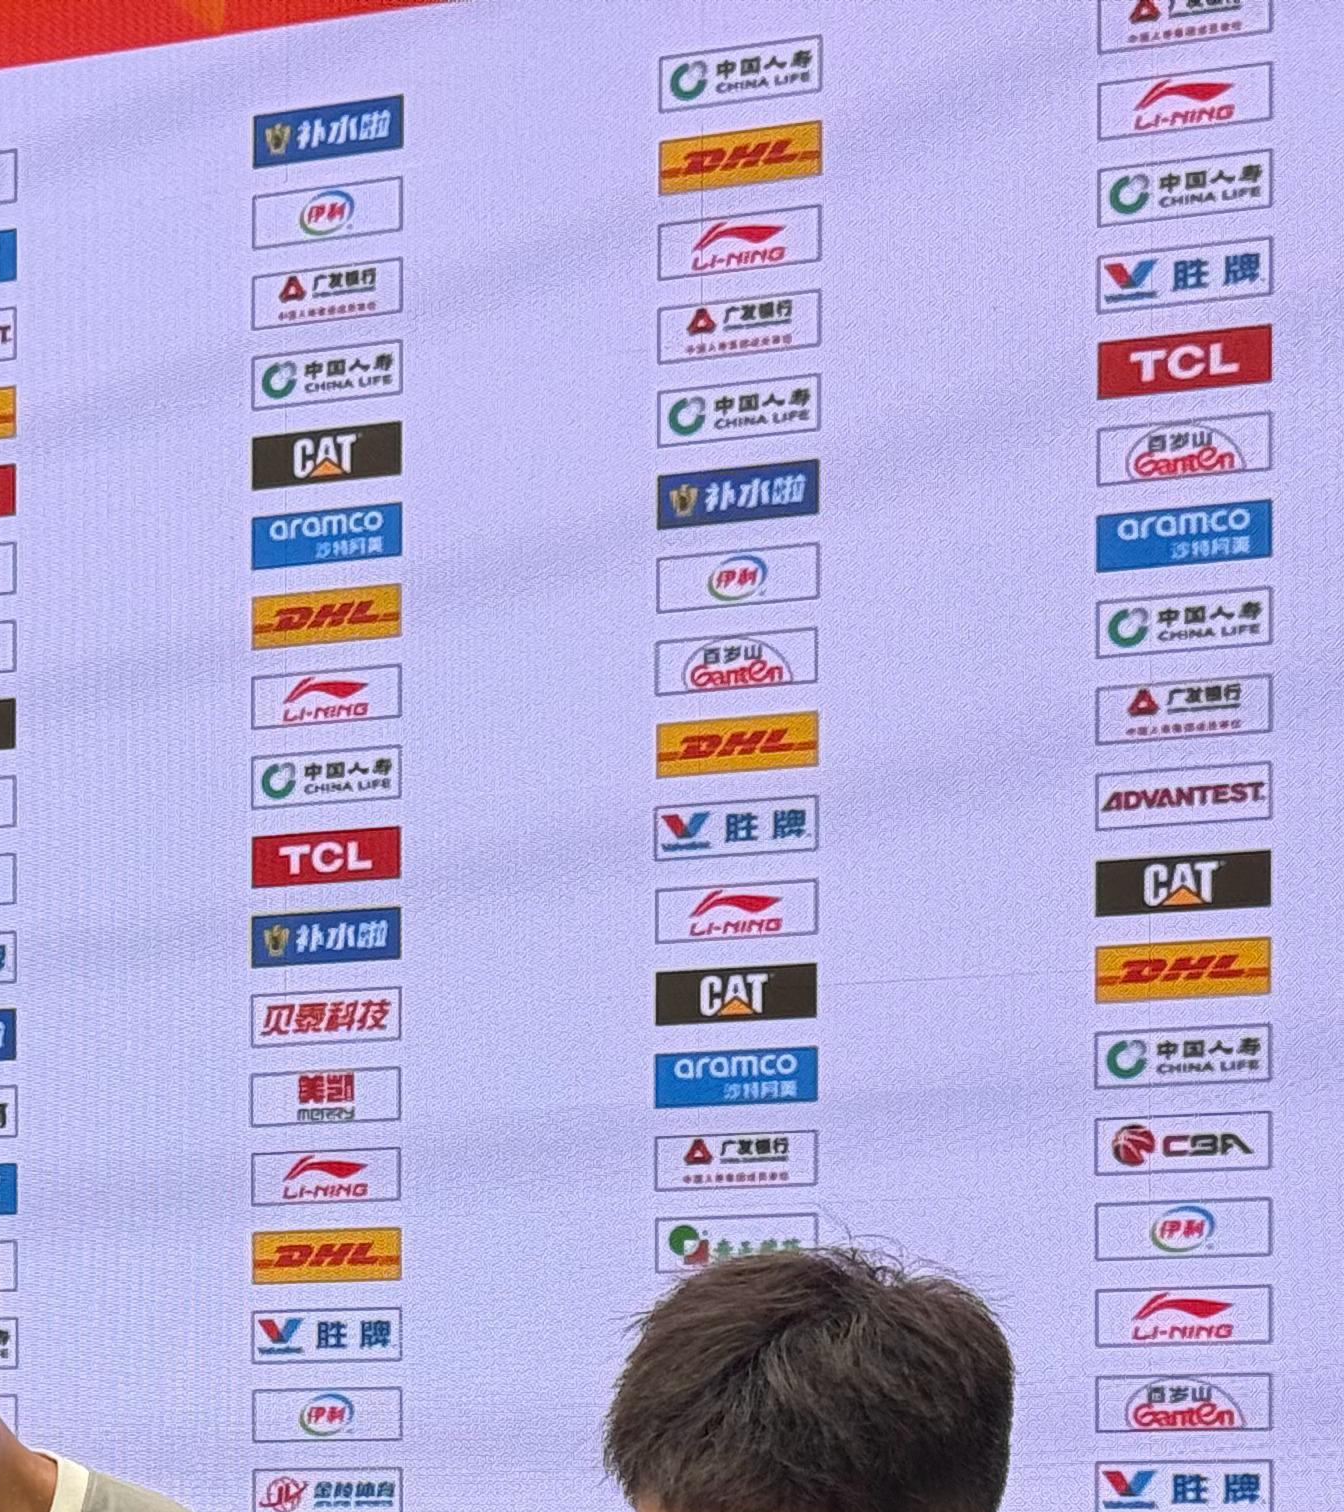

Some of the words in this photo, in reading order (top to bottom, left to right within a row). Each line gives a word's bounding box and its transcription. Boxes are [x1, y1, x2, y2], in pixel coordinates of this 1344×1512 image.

[717, 49, 811, 79] 中国人寿
[716, 76, 770, 94] CHINA
[775, 70, 811, 86] LIFE
[297, 108, 389, 150] 补水啦
[1136, 105, 1236, 131] LI-NING
[681, 138, 797, 177] DHL
[1160, 163, 1262, 194] 中国人寿
[1160, 190, 1218, 208] CHINA
[1223, 185, 1262, 201] LIFE
[692, 246, 786, 270] LI-NING
[1173, 251, 1261, 291] 胜牌
[304, 352, 392, 379] 中国人寿
[1129, 341, 1241, 385] TCL
[304, 377, 354, 393] CHINA
[359, 373, 392, 387] LIFE
[714, 388, 809, 415] 中国人寿
[714, 413, 768, 430] CHINA
[773, 409, 809, 423] LIFE
[1148, 430, 1213, 452] 百岁山
[293, 433, 356, 479] CAT
[705, 472, 805, 512] 补水啦
[269, 510, 383, 541] aramco
[1117, 508, 1251, 541] aramco
[272, 599, 379, 632] DHL
[1158, 601, 1260, 627] 中国人寿
[1158, 626, 1216, 642] CHINA
[1222, 622, 1261, 636] LIFE
[702, 643, 763, 664] 百岁山
[283, 702, 369, 722] LI-NING
[678, 727, 794, 760] DHL
[304, 758, 391, 781] 中国人寿
[304, 781, 354, 795] CHINA
[358, 778, 391, 790] LIFE
[1101, 781, 1265, 812] ADVANTEST
[725, 808, 807, 843] 胜牌
[278, 840, 374, 877] TCL
[1144, 860, 1218, 907] CAT
[296, 919, 388, 953] 补水啦
[689, 918, 782, 936] LI-NING
[1120, 953, 1246, 984] DHL
[699, 973, 767, 1017] CAT
[1157, 1037, 1260, 1060] 中国人寿
[673, 1053, 797, 1079] aramco
[1157, 1061, 1216, 1074] CHINA
[1221, 1058, 1260, 1071] LIFE
[1163, 1131, 1254, 1157] CBA
[316, 1320, 391, 1349] 胜牌
[1132, 1324, 1234, 1340] LI-NING
[1146, 1385, 1212, 1403] 百岁山
[1172, 1473, 1261, 1504] 胜牌
